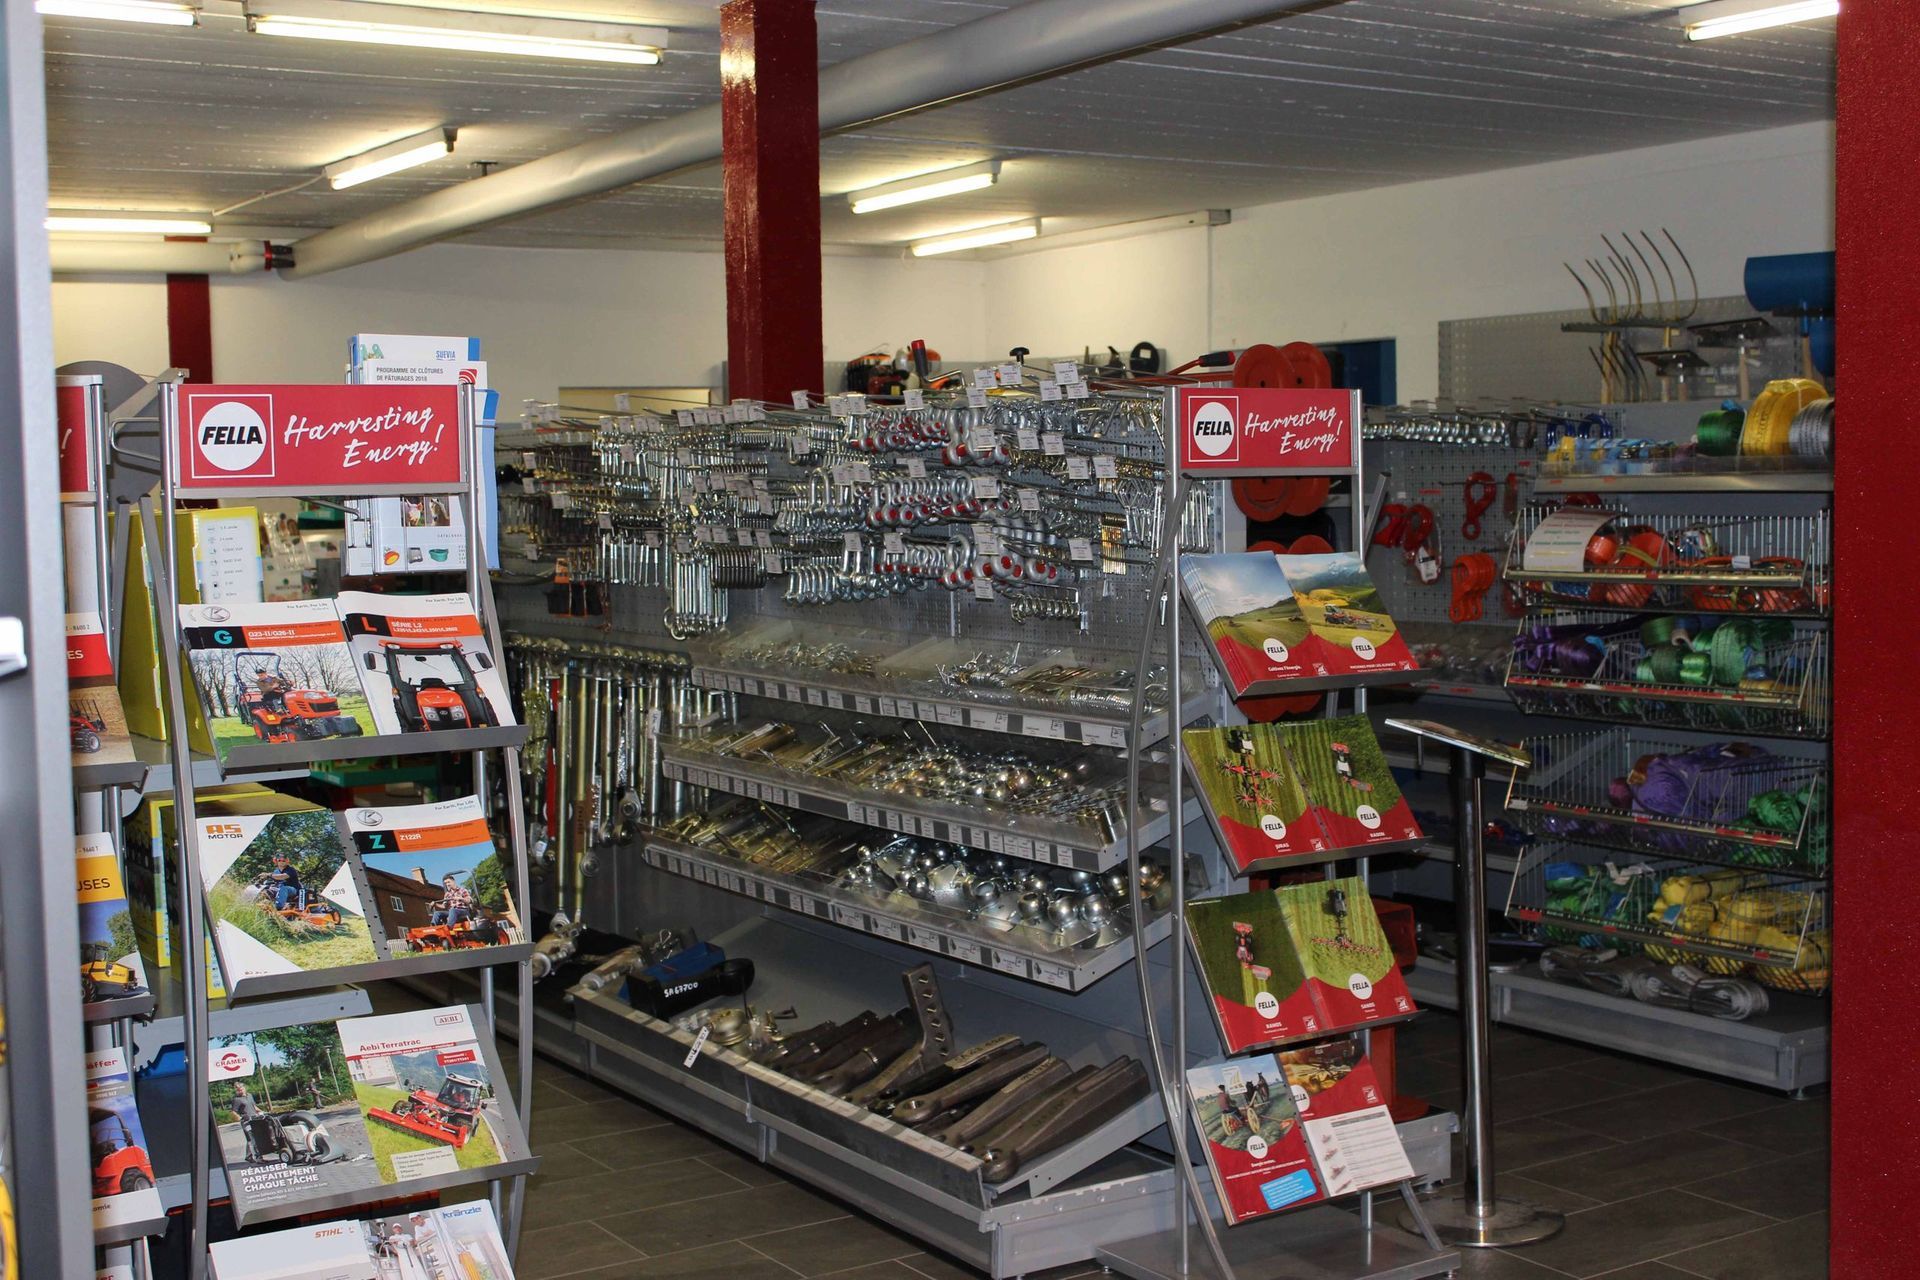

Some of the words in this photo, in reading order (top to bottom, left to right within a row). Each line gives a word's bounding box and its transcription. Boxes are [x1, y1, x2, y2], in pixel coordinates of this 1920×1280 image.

[284, 406, 434, 447] Harvesting
[1195, 421, 1232, 436] FELLA
[1244, 406, 1337, 438] Harvesting
[201, 426, 263, 445] FELLA
[1280, 420, 1343, 455] Energy!
[343, 424, 445, 468] Energy!
[361, 616, 377, 632] L
[214, 629, 233, 645] G
[1264, 823, 1283, 831] FELLA
[369, 834, 385, 849] Z
[1352, 982, 1369, 990] FELLA
[1258, 1001, 1276, 1009] FELLA
[439, 1015, 458, 1024] AEBI
[360, 1043, 380, 1052] Aebi
[381, 1039, 421, 1049] Terratrac
[216, 1058, 247, 1067] CRAMER
[241, 1162, 288, 1176] RÉALISER
[242, 1166, 316, 1184] PARFAITEMENT
[245, 1179, 286, 1192] CHAQUE
[286, 1174, 319, 1185] TÂCHE
[315, 1228, 343, 1238] STIHL
